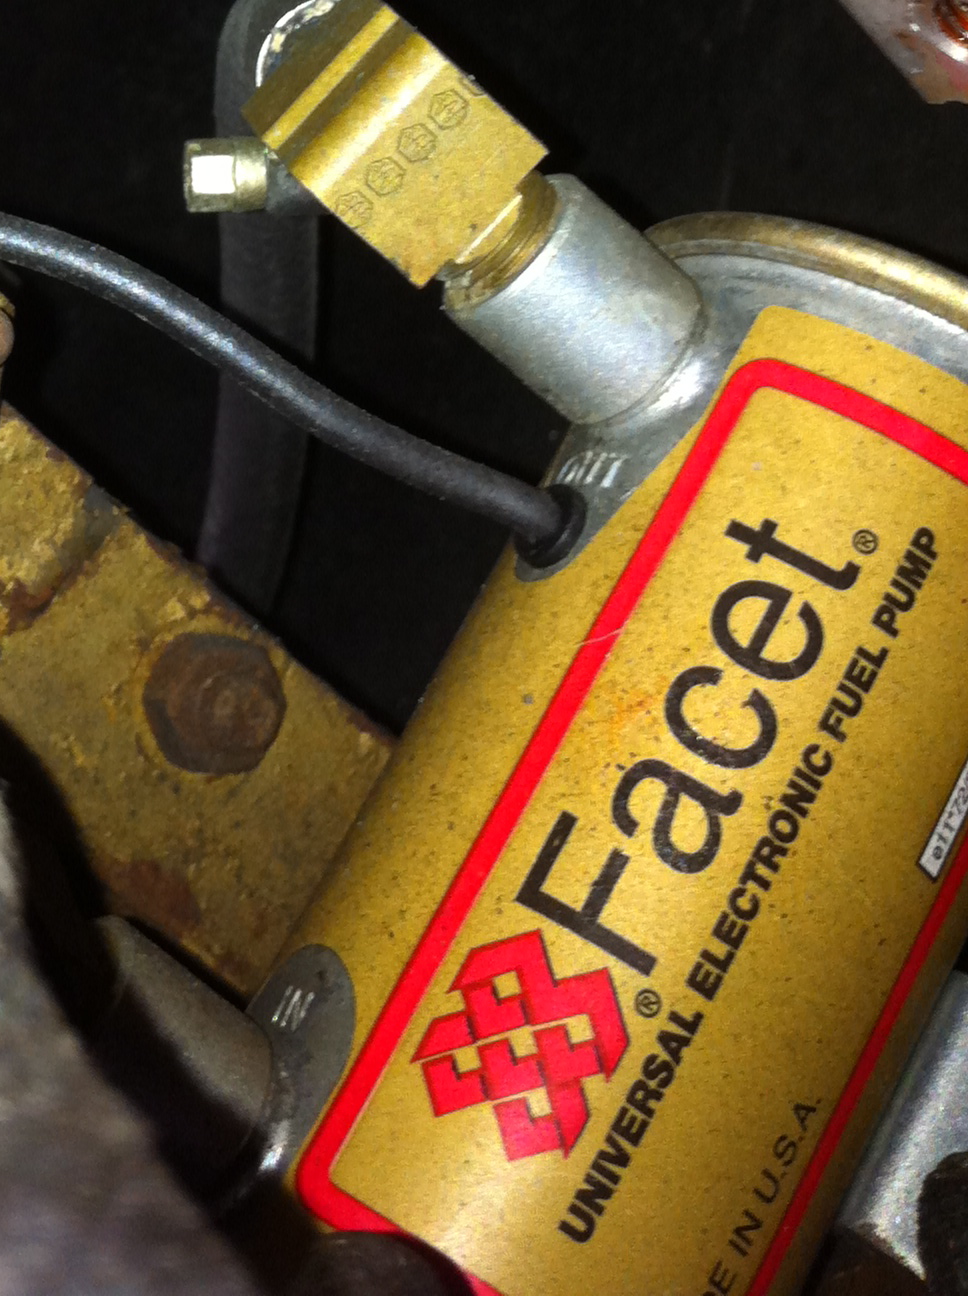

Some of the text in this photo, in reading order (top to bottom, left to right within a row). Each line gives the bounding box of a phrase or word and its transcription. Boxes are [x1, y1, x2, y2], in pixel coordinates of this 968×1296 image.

[556, 525, 939, 1244] UNIVERSAL ELECTRONIC FUEL PUMP
[727, 1208, 765, 1258] IN
[752, 1096, 824, 1207] U.S.A.
